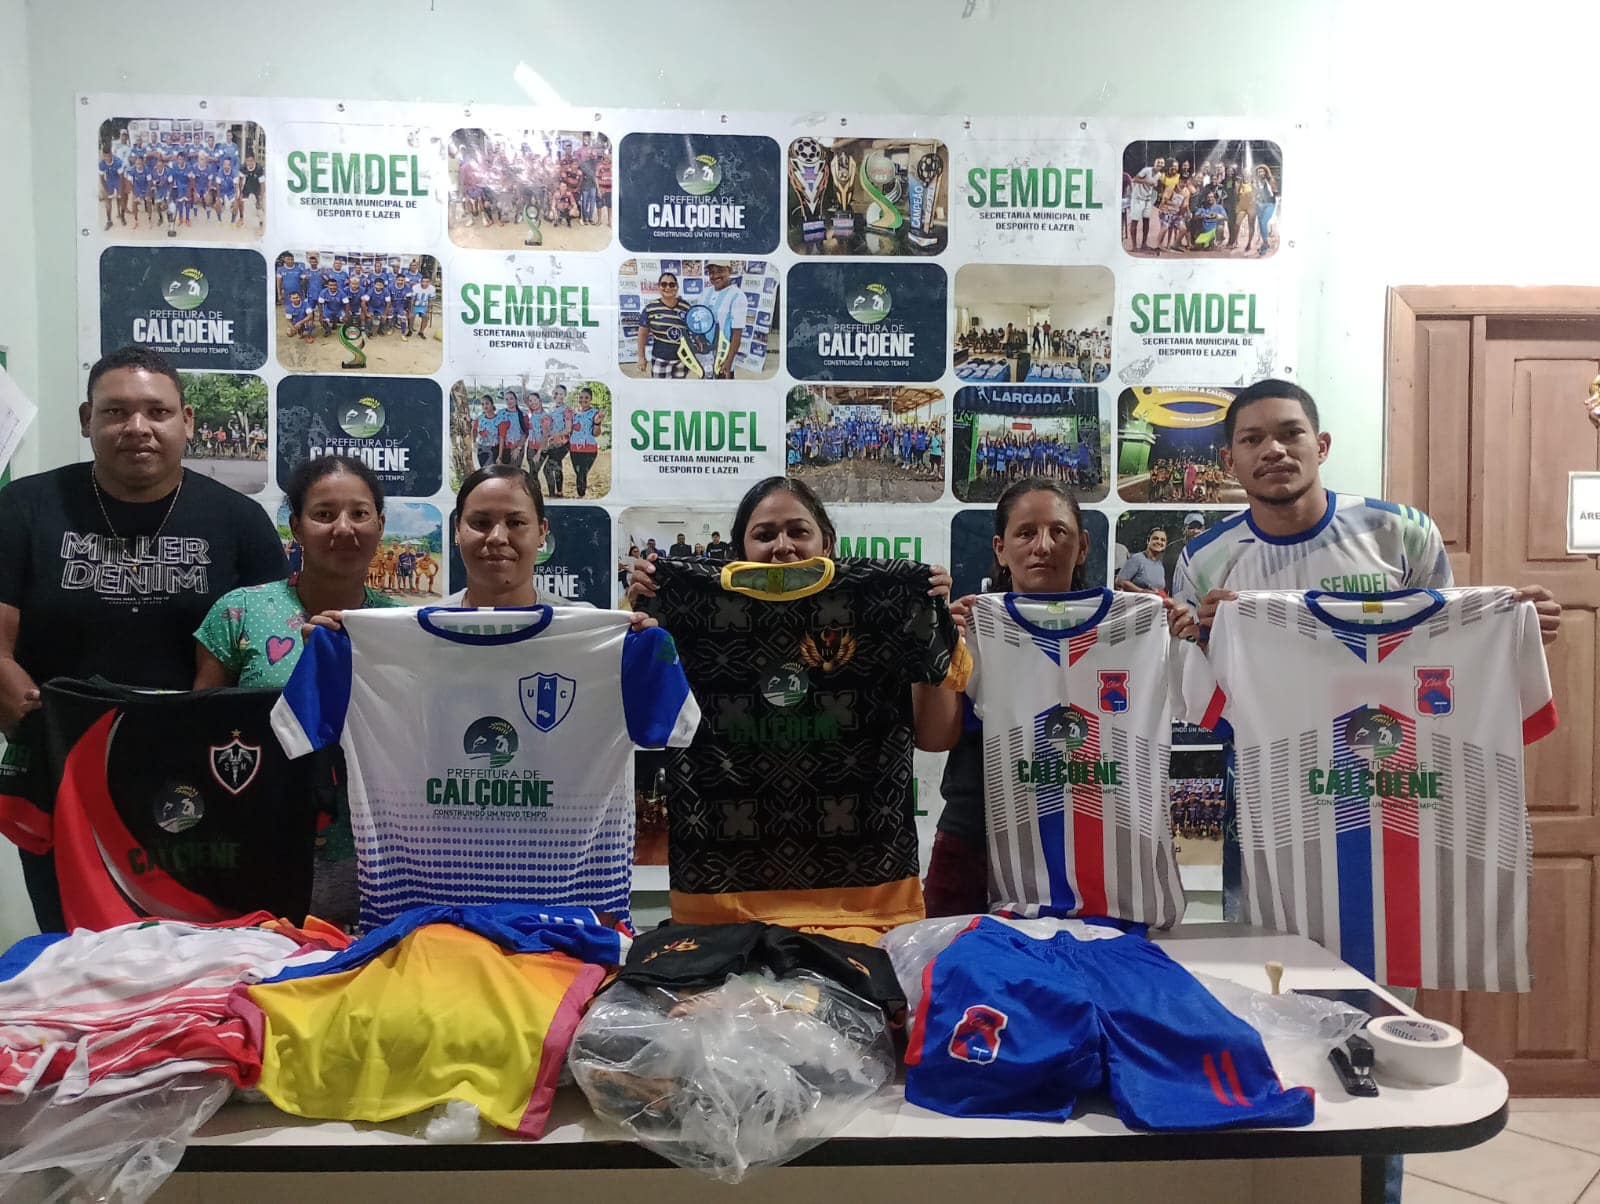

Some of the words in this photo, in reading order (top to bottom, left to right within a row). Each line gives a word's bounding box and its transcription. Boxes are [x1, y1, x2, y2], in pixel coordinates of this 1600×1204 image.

[287, 151, 428, 196] SEMDEL
[968, 168, 1103, 209] SEMDEL
[300, 197, 352, 206] SECRETARIA
[356, 198, 403, 208] MUNICIPAL
[406, 200, 416, 208] DE
[664, 195, 718, 205] PREFEITURA
[721, 196, 734, 205] DE
[317, 208, 362, 218] DESPORTO
[365, 210, 371, 218] E
[372, 210, 400, 219] LAZER
[648, 204, 745, 232] CALÇOENE
[980, 212, 1030, 220] SECRETARIA
[1033, 212, 1077, 220] MUNICIPAL
[1080, 213, 1090, 221] DE
[996, 222, 1038, 230] DESPORTO
[1049, 224, 1074, 232] LAZER
[461, 283, 600, 327] SEMDEL
[150, 310, 205, 319] PREFEITURA
[208, 310, 222, 320] DE
[1130, 293, 1264, 334] SEMDEL
[133, 318, 234, 346] CALÇOENE
[473, 329, 525, 338] SECRETARIA
[527, 330, 574, 339] MUNICIPAL
[834, 324, 888, 332] PREFEITURA
[892, 324, 904, 333] DE
[490, 340, 534, 349] DESPORTO
[544, 342, 570, 350] LAZER
[818, 332, 914, 360] CALÇOENE
[1142, 338, 1193, 346] SECRETARIA
[1196, 338, 1240, 346] MUNICIPAL
[1159, 348, 1202, 356] DESPORTO
[1211, 349, 1237, 357] LAZER
[992, 390, 1061, 404] LARGADA
[631, 410, 767, 452] SEMDEL
[326, 438, 382, 447] PREFEITURA
[386, 439, 400, 448] DE
[659, 466, 702, 474] DESPORTO
[712, 466, 738, 474] LAZER
[61, 531, 212, 565] MILLER
[61, 560, 209, 594] DENIM
[528, 688, 534, 698] U
[560, 690, 568, 699] C
[448, 768, 518, 778] PREFEITURA
[523, 770, 540, 780] DE
[426, 778, 554, 810] CALÇOENE
